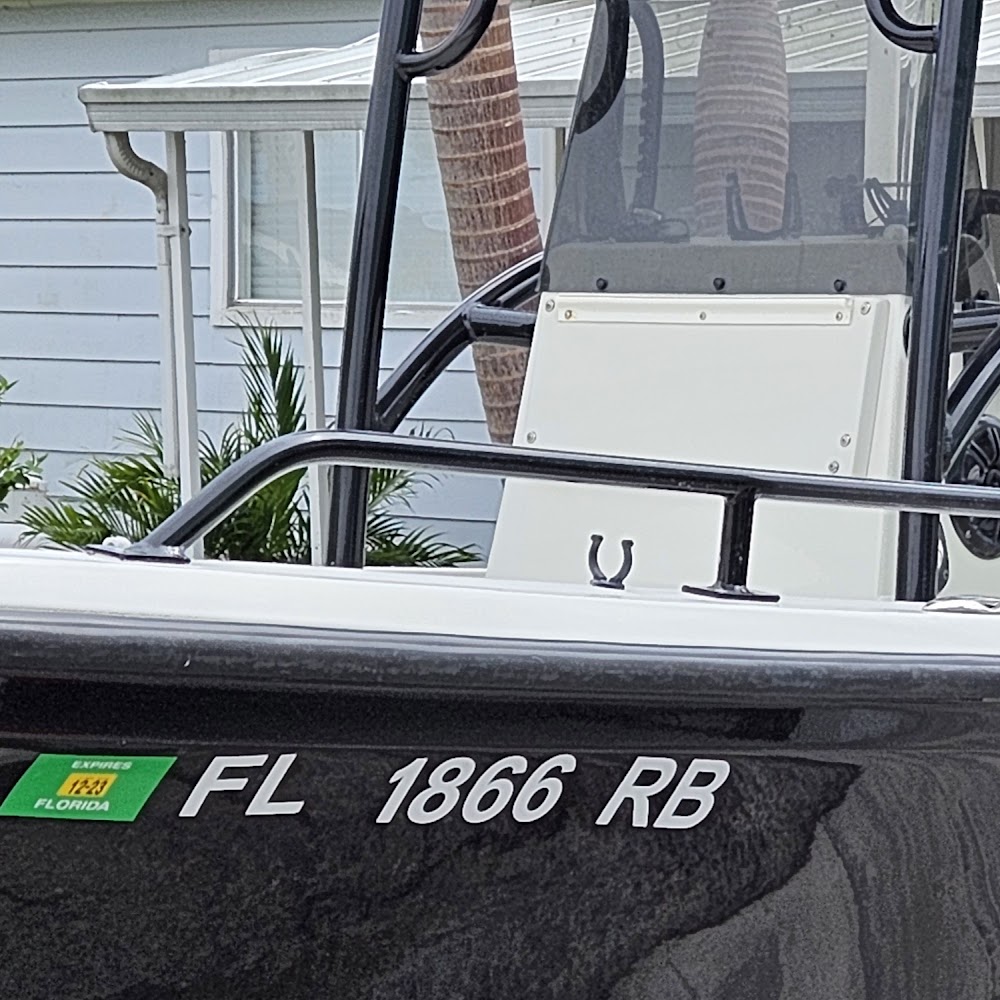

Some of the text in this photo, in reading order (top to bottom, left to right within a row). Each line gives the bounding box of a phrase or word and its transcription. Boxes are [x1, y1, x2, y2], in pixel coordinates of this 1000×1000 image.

[71, 760, 133, 770] EXPIRES
[68, 779, 108, 796] 12-23
[178, 753, 731, 829] FL 1866 RB
[33, 798, 110, 811] FLORIDA
